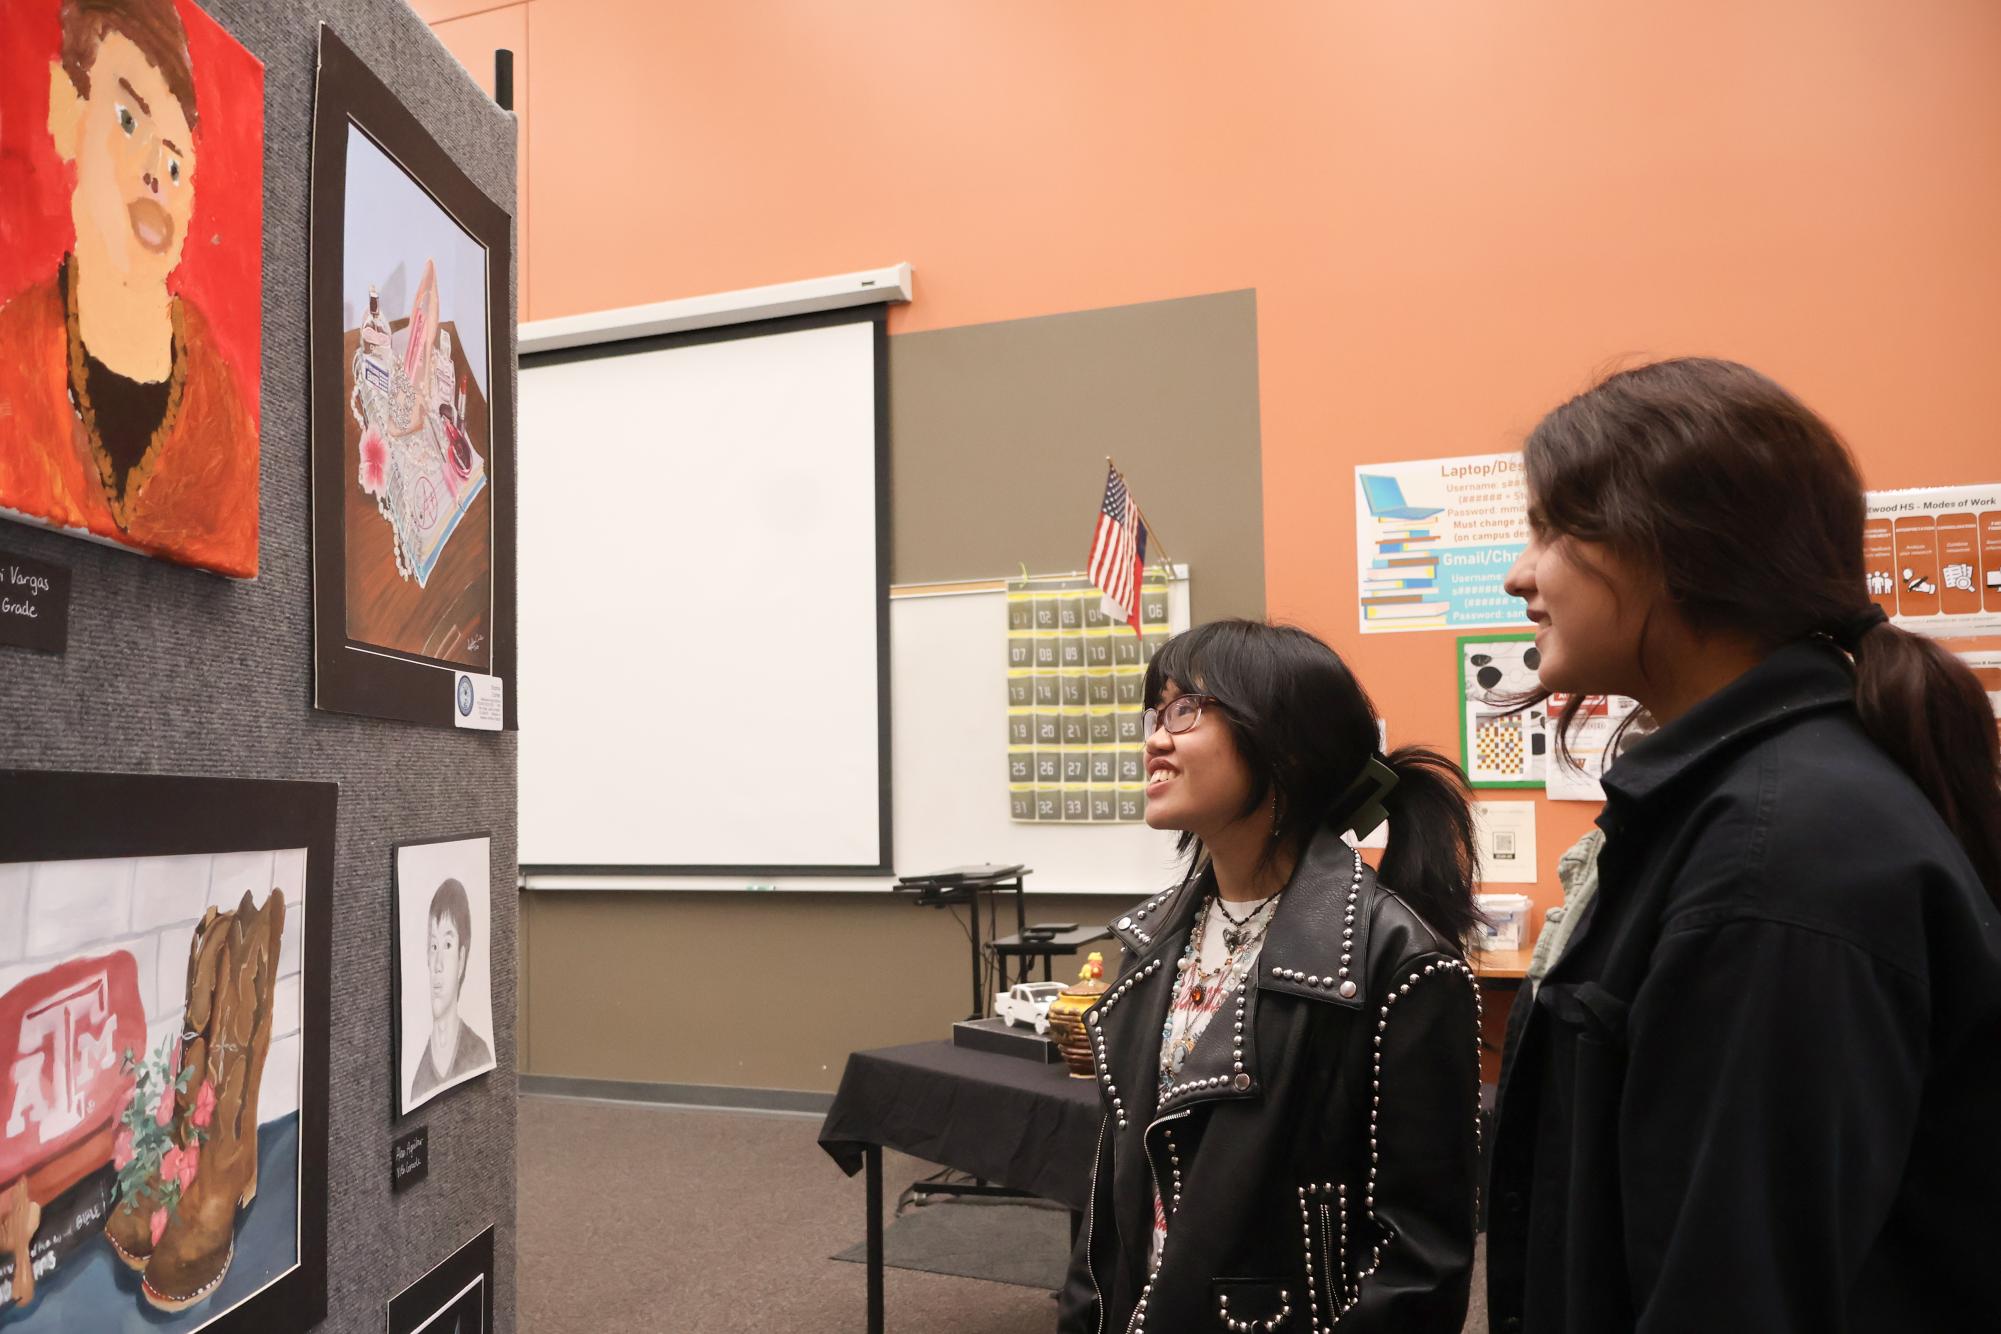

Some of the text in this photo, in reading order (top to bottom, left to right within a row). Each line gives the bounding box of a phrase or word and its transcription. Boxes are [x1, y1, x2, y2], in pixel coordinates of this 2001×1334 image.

[1442, 460, 1526, 479] Laptop/Des
[1866, 503, 1897, 513] twood
[1900, 502, 1915, 511] HS
[1923, 501, 1956, 510] Modes
[1958, 499, 1968, 507] of
[1971, 497, 1997, 506] Work
[1480, 518, 1515, 528] change
[1472, 532, 1510, 541] campus
[1443, 550, 1520, 566] Gmail/Chr
[10, 566, 49, 595] Vargas
[1, 597, 38, 618] Grade
[1039, 611, 1052, 624] 02
[1062, 611, 1075, 624] 03
[1148, 604, 1163, 618] 06
[1012, 648, 1026, 661] 07
[1065, 647, 1078, 661] 09
[1091, 646, 1106, 660] 10
[1121, 644, 1135, 658] 11
[1011, 684, 1135, 700] 13 14 15 16 17
[1013, 722, 1136, 738] 19 20 21 22 23
[1012, 761, 1137, 776] 25 26 27 28 29
[1015, 800, 1136, 814] 31 32 33 34 35
